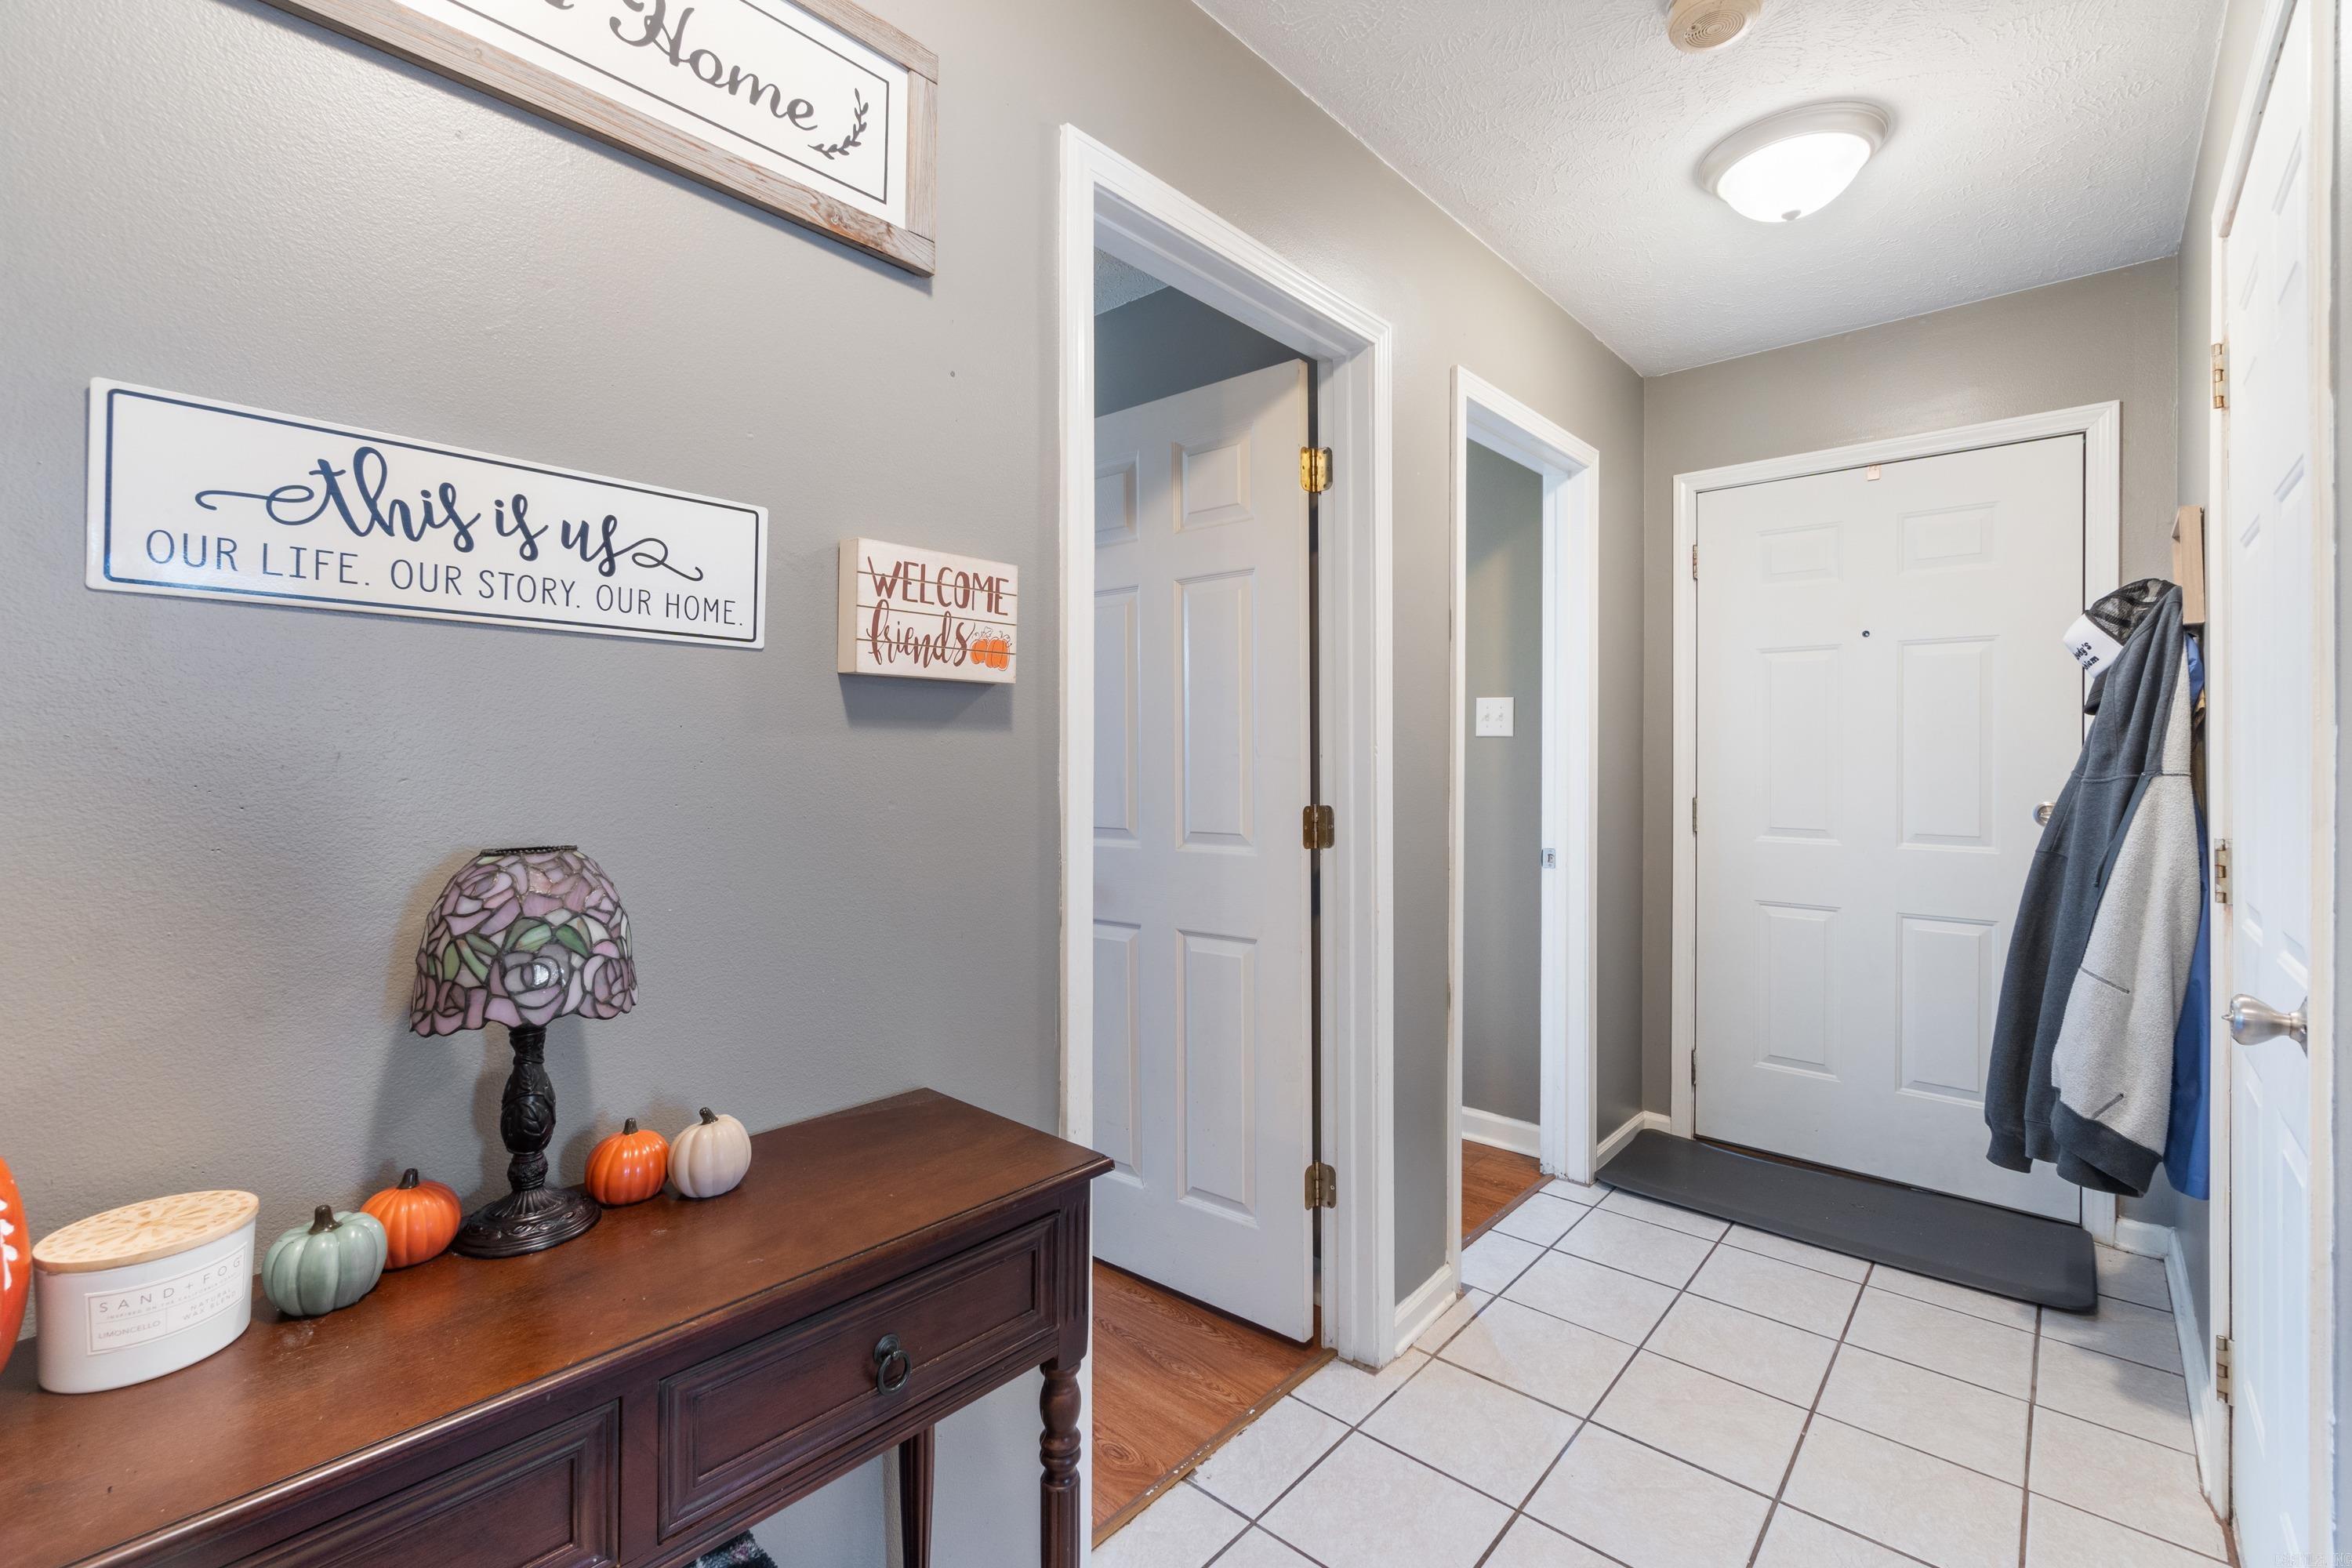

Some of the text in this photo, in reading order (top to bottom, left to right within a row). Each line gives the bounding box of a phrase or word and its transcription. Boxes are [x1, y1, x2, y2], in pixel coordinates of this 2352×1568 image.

[609, 0, 818, 131] Home
[195, 446, 481, 554] this
[495, 493, 549, 562] is
[146, 529, 744, 626] OUR LIFE. OUR STORY. OUR HOME.
[868, 556, 1009, 615] WELCOME
[866, 599, 975, 668] friends
[100, 1288, 175, 1312] SAND
[203, 1255, 240, 1284] FOG
